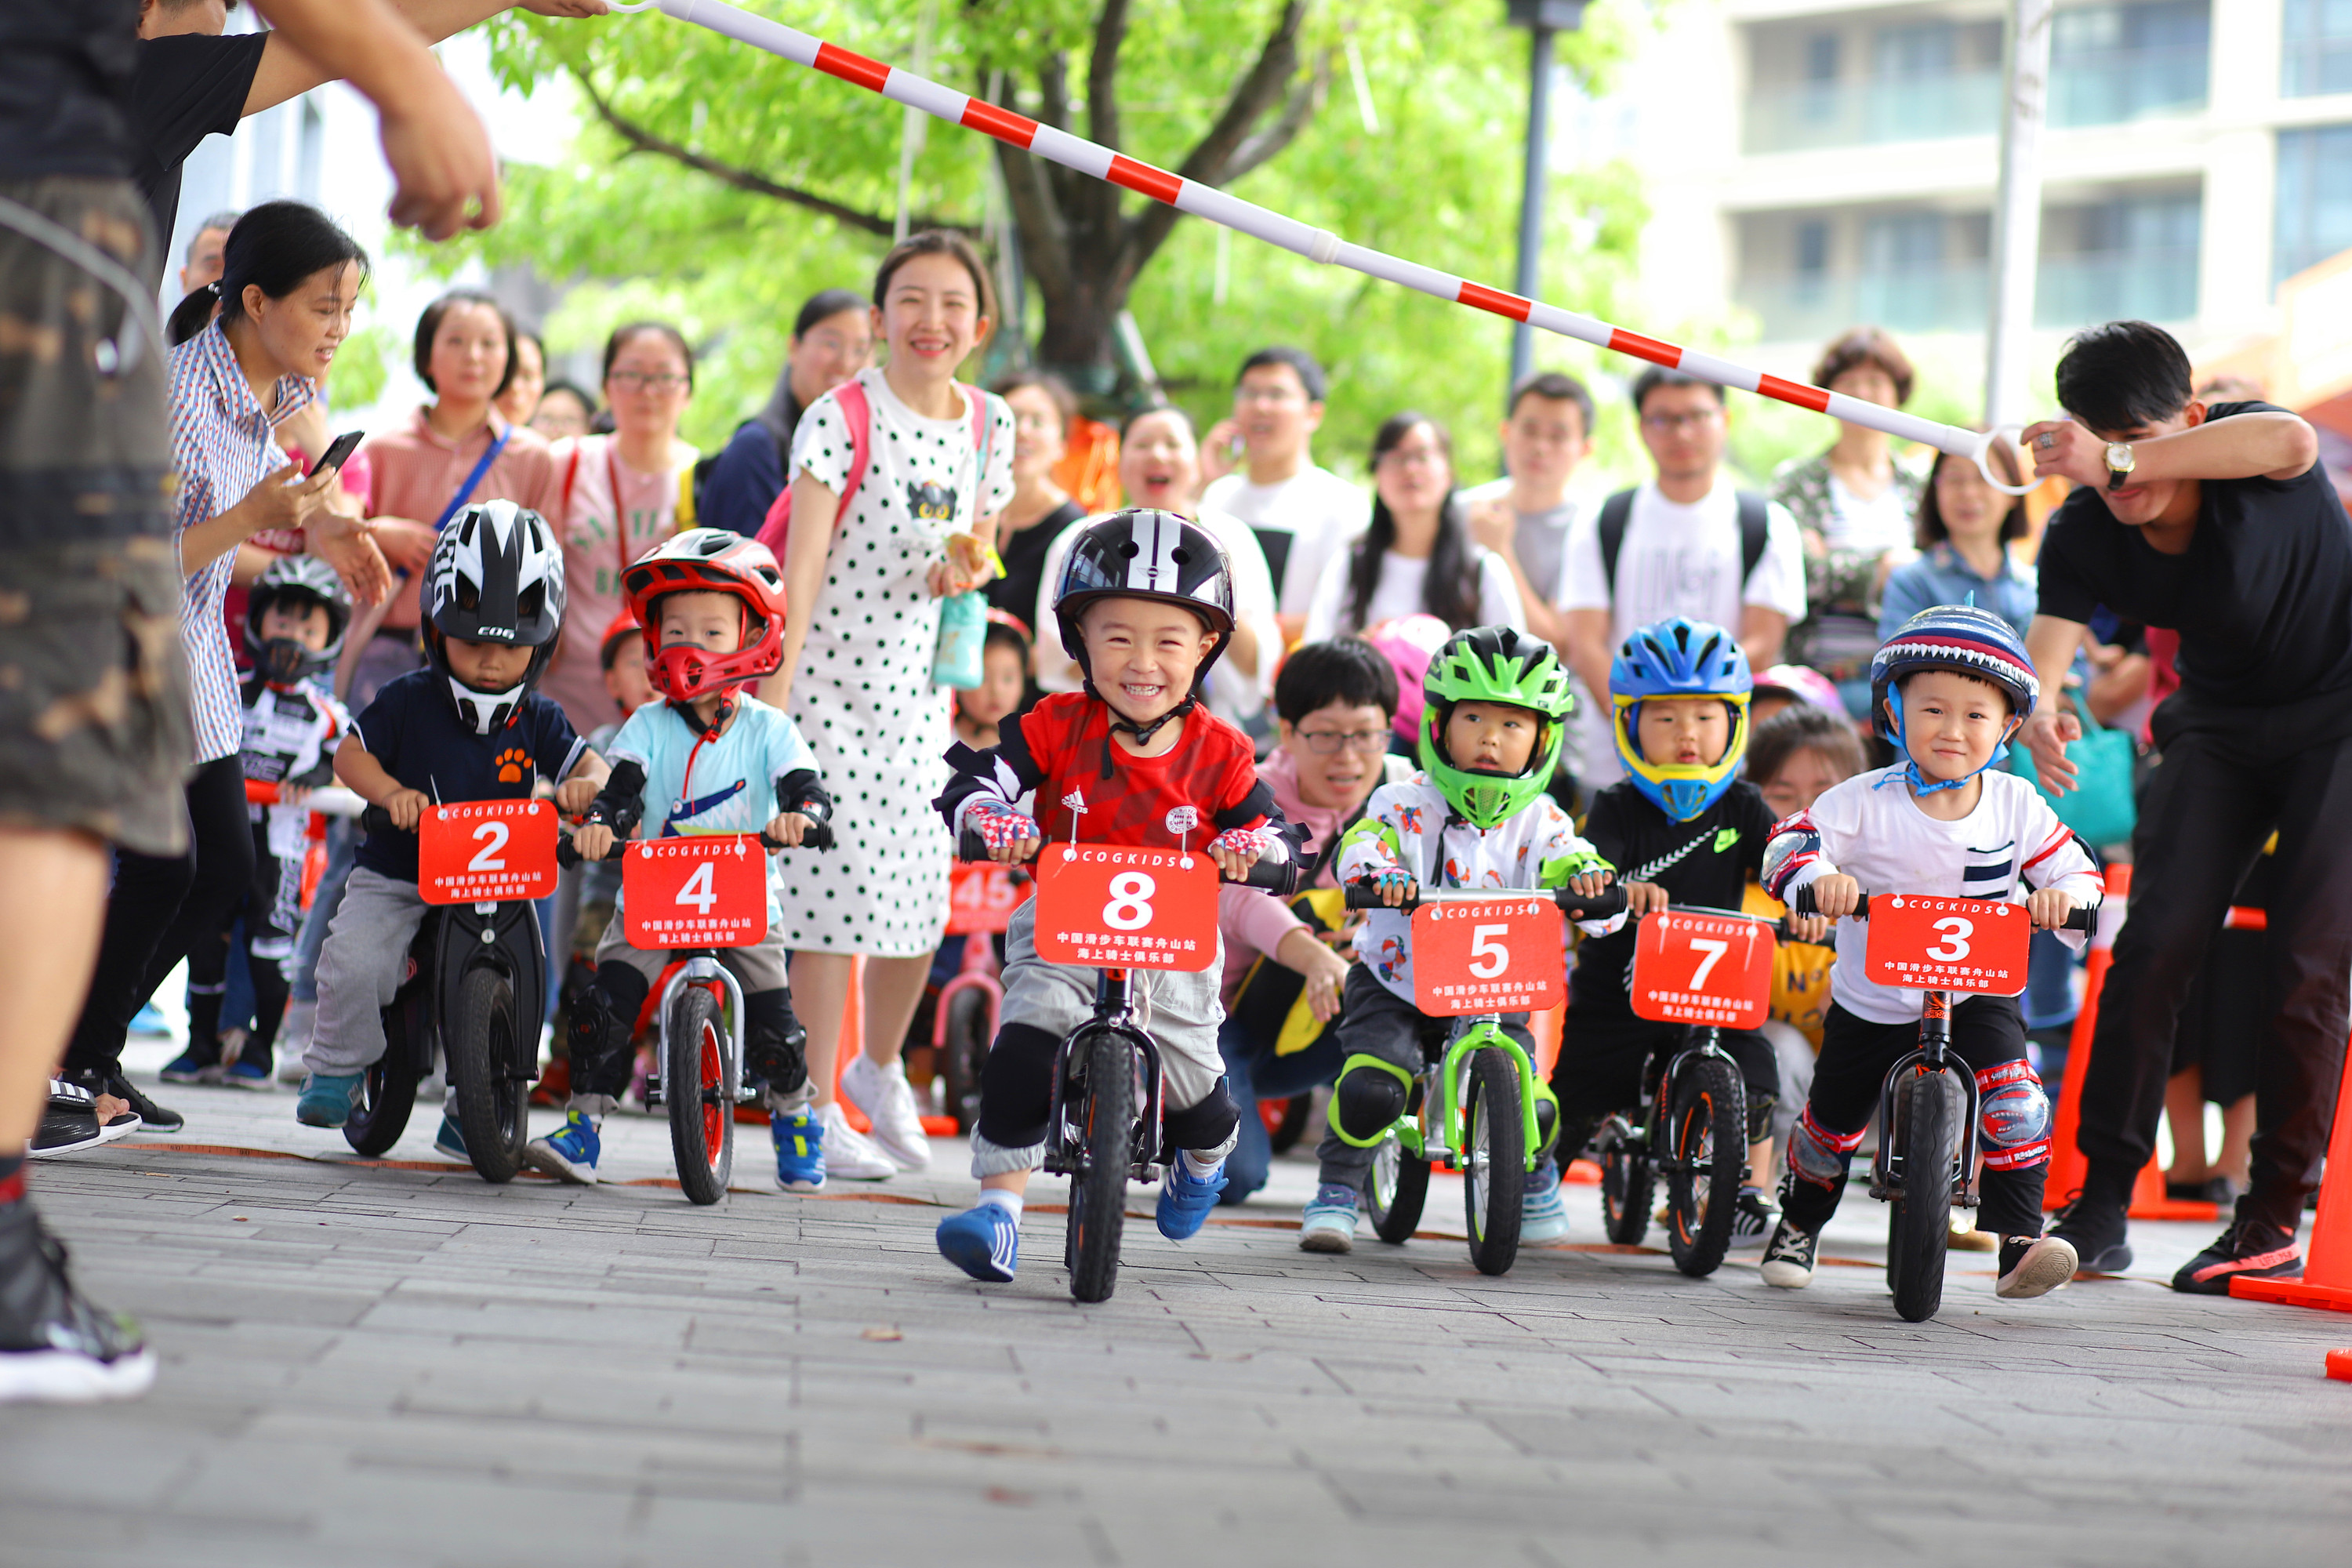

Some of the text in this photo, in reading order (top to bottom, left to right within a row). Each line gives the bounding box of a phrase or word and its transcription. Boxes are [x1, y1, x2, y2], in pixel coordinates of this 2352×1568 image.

[452, 805, 523, 818] COGKIDS
[1062, 798, 1088, 815] adidas
[467, 821, 510, 872] 2
[658, 845, 730, 856] COGKIDS
[1083, 851, 1175, 866] COGKIDS
[435, 873, 540, 886] 中国滑步车联赛舟山站
[452, 885, 524, 897] 海上骑士俱乐部
[676, 862, 717, 914] 4
[1102, 872, 1156, 930] 8
[1910, 900, 1992, 913] COGKIDS
[1447, 905, 1524, 918] COGKIDS
[642, 918, 750, 931] 中国滑步车联赛舟山站
[1673, 919, 1747, 935] COGKIDS
[659, 931, 735, 943] 海上骑士俱乐部
[1058, 932, 1196, 950] 中国滑步车联赛舟山站
[1926, 917, 1973, 961] 3
[1077, 948, 1174, 964] 海上骑士俱乐部
[1468, 924, 1509, 978] 5
[1690, 938, 1728, 989] 7
[1885, 961, 2008, 980] 中国滑步车联赛舟山站
[1433, 981, 1546, 996] 中国滑步车联赛舟山站
[1903, 974, 1988, 988] 海上骑士俱乐部
[1450, 996, 1530, 1009] 海上骑士俱乐部
